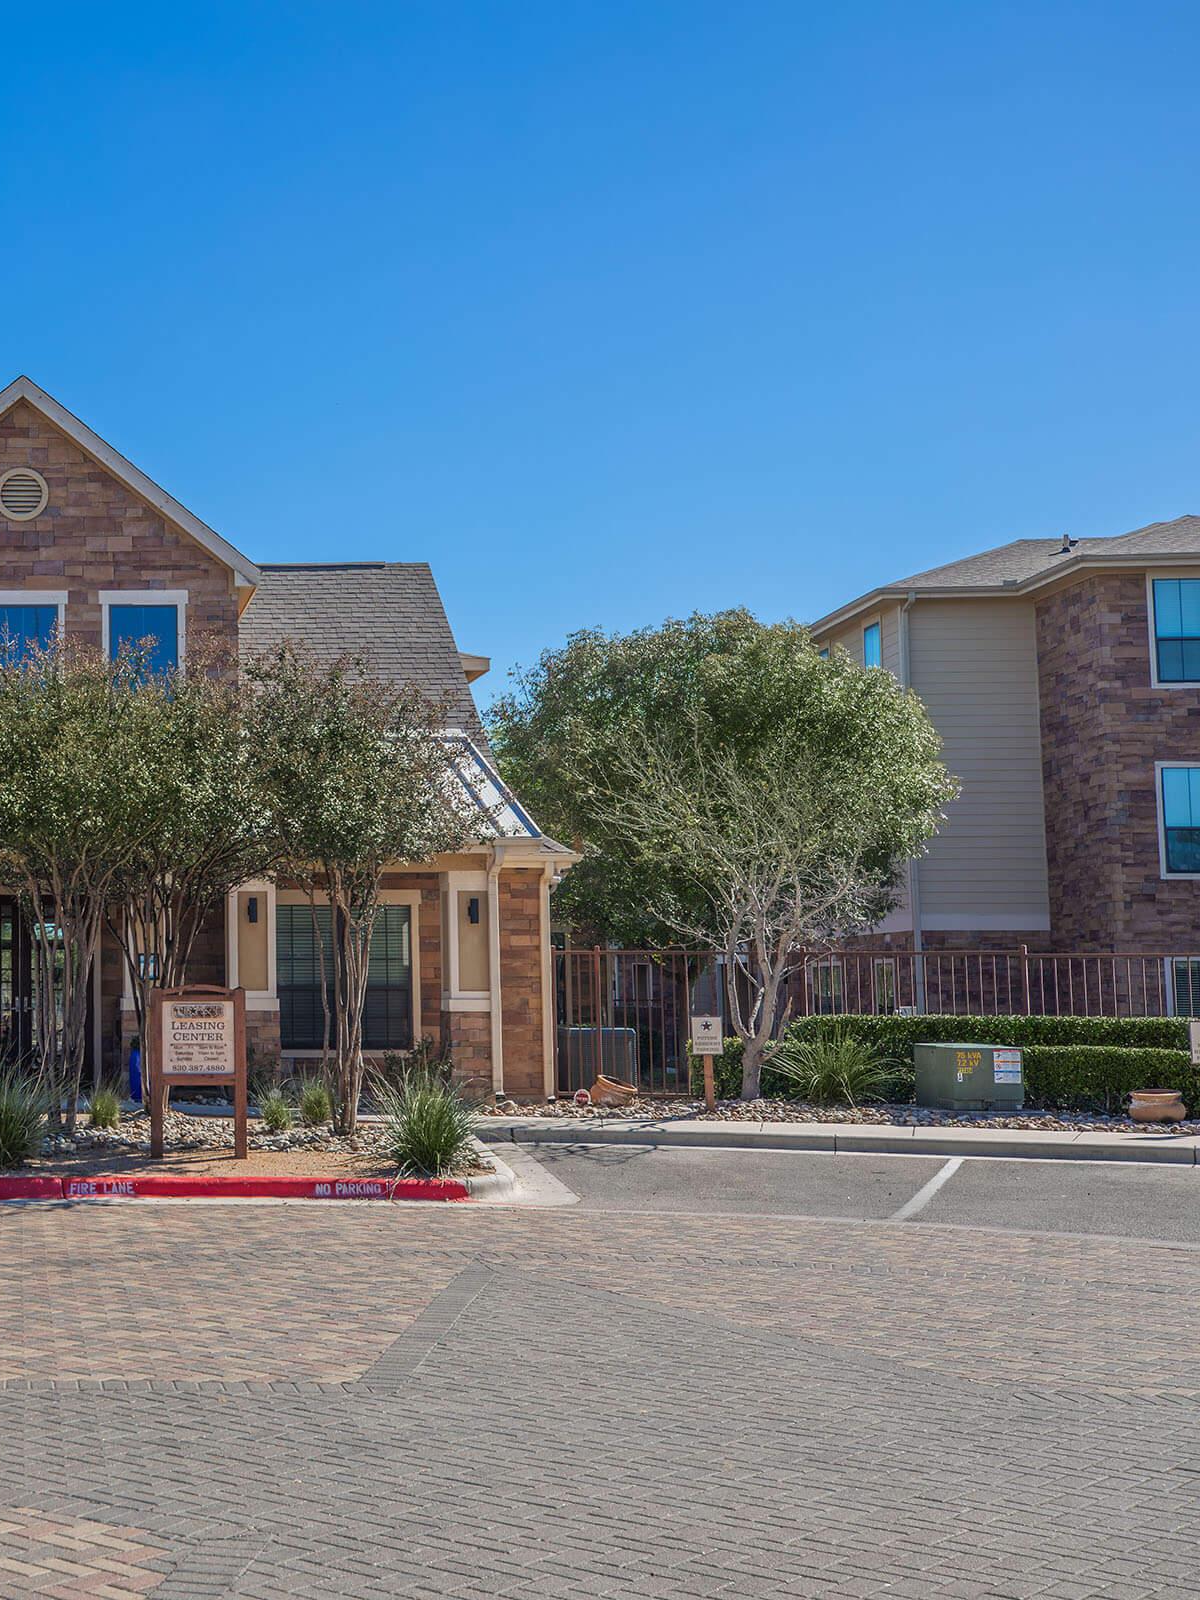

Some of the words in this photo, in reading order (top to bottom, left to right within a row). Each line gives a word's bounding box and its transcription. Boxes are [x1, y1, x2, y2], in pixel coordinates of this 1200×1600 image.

[171, 1021, 225, 1030] LEASING
[173, 1032, 224, 1041] CENTER
[70, 1182, 97, 1195] FIRE
[104, 1182, 135, 1195] LANE
[316, 1183, 331, 1195] NO
[336, 1183, 381, 1195] PARKING
